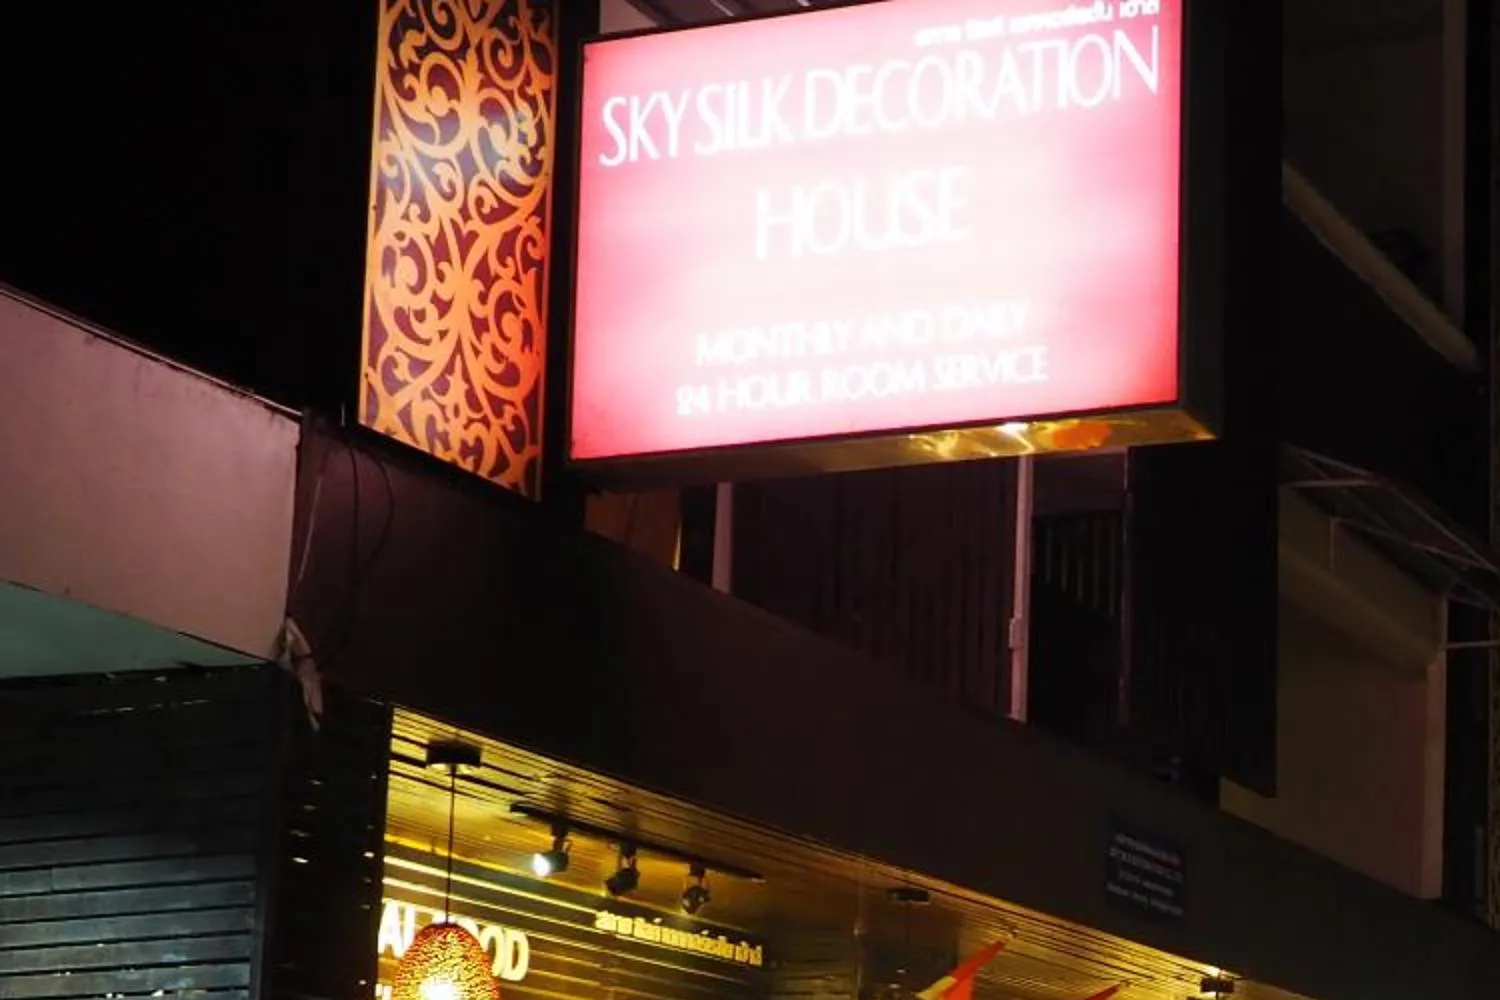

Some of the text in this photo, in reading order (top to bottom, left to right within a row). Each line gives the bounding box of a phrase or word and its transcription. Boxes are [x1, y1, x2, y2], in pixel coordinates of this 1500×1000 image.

[598, 25, 1161, 168] SKY SILK DECORATION
[754, 165, 972, 260] HOUSE
[696, 296, 1035, 368] MONTHLY AND DAILY
[675, 345, 1051, 417] 24 HOUR ROOM SERVICE
